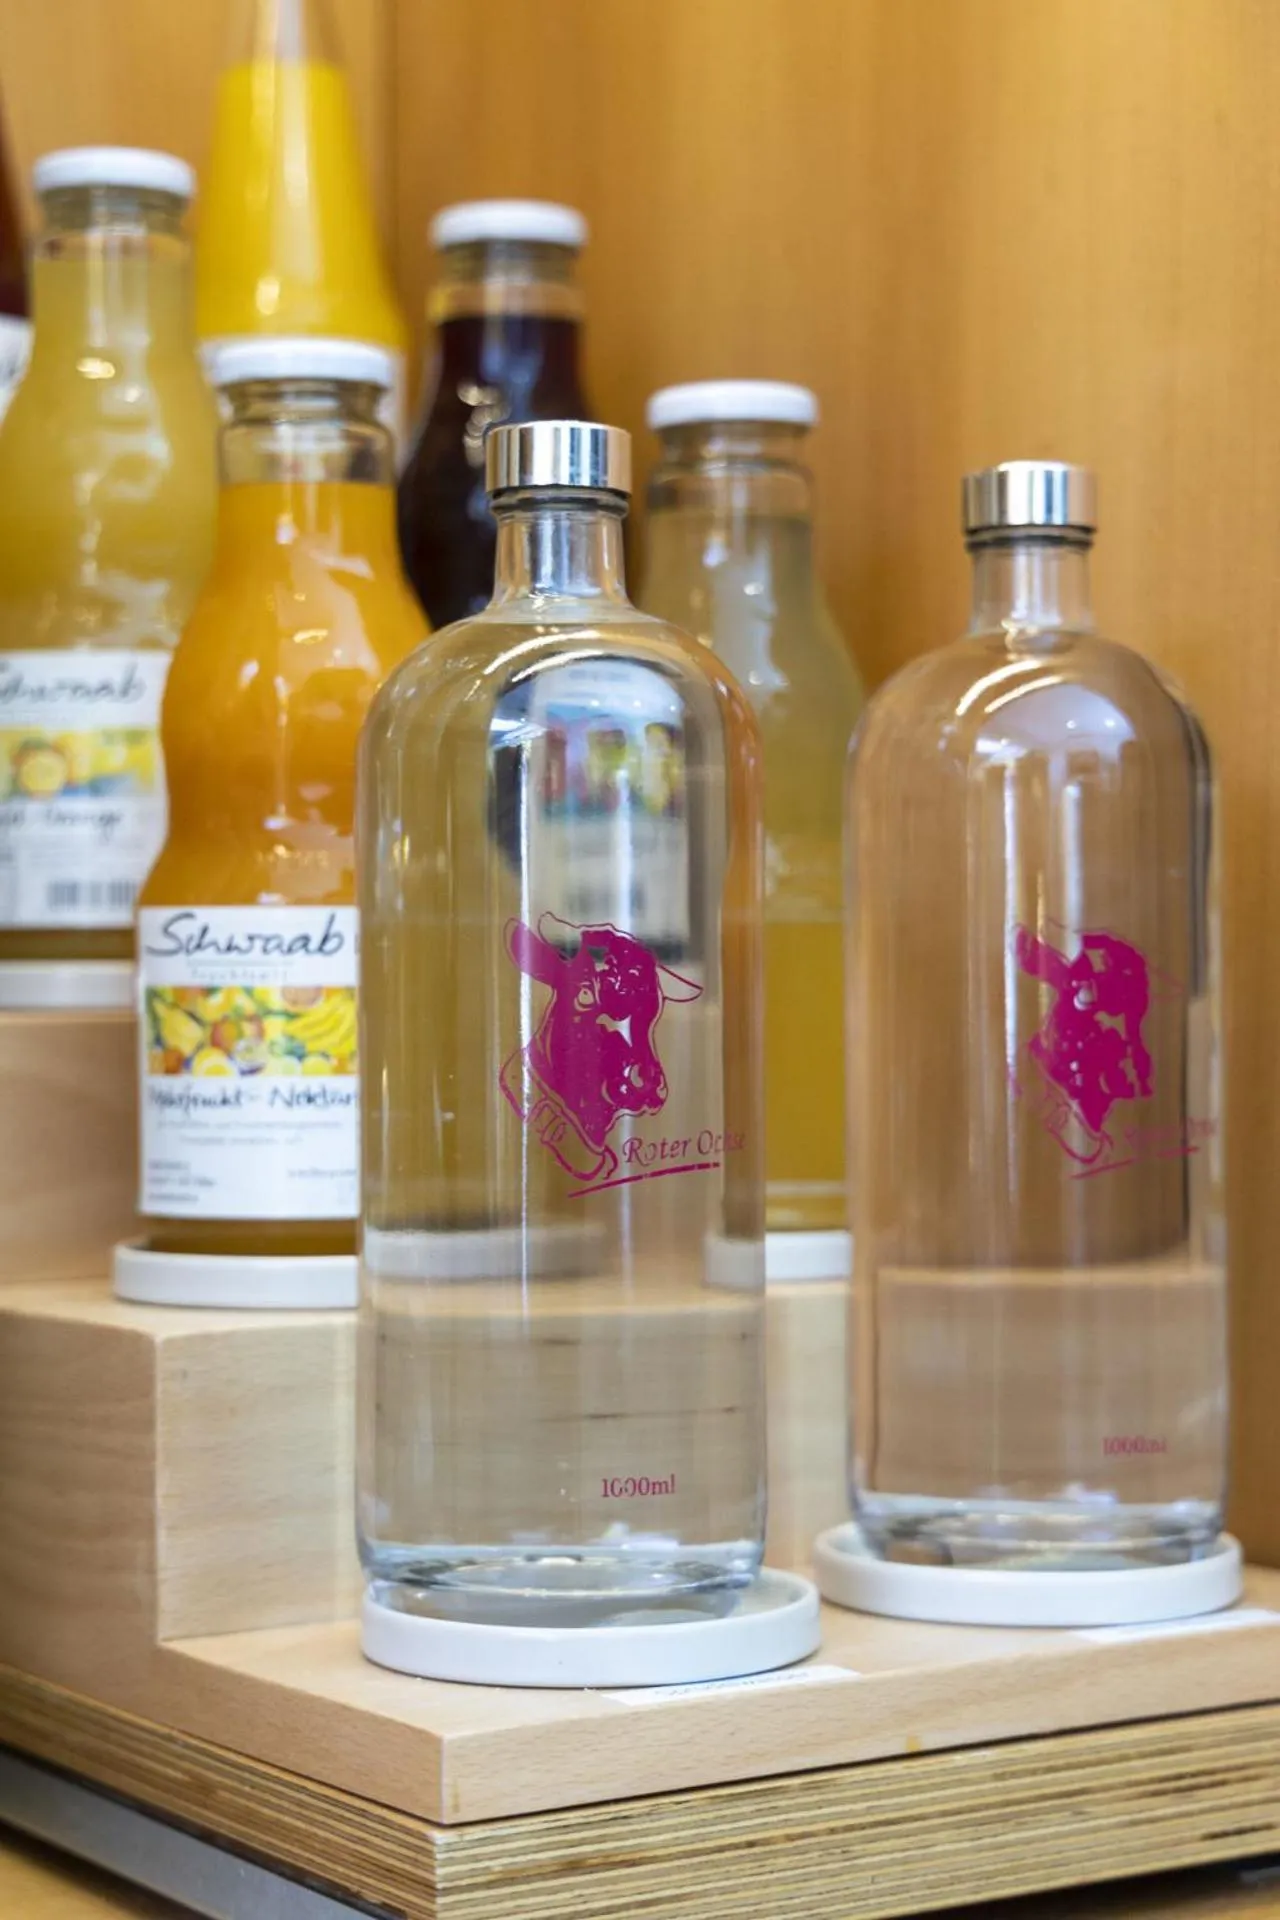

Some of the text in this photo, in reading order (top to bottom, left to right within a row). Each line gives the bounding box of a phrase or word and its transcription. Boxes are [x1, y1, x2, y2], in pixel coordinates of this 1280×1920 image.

[145, 912, 344, 957] Schwaab
[622, 1136, 692, 1167] Roter
[601, 1473, 675, 1498] 1000ml
